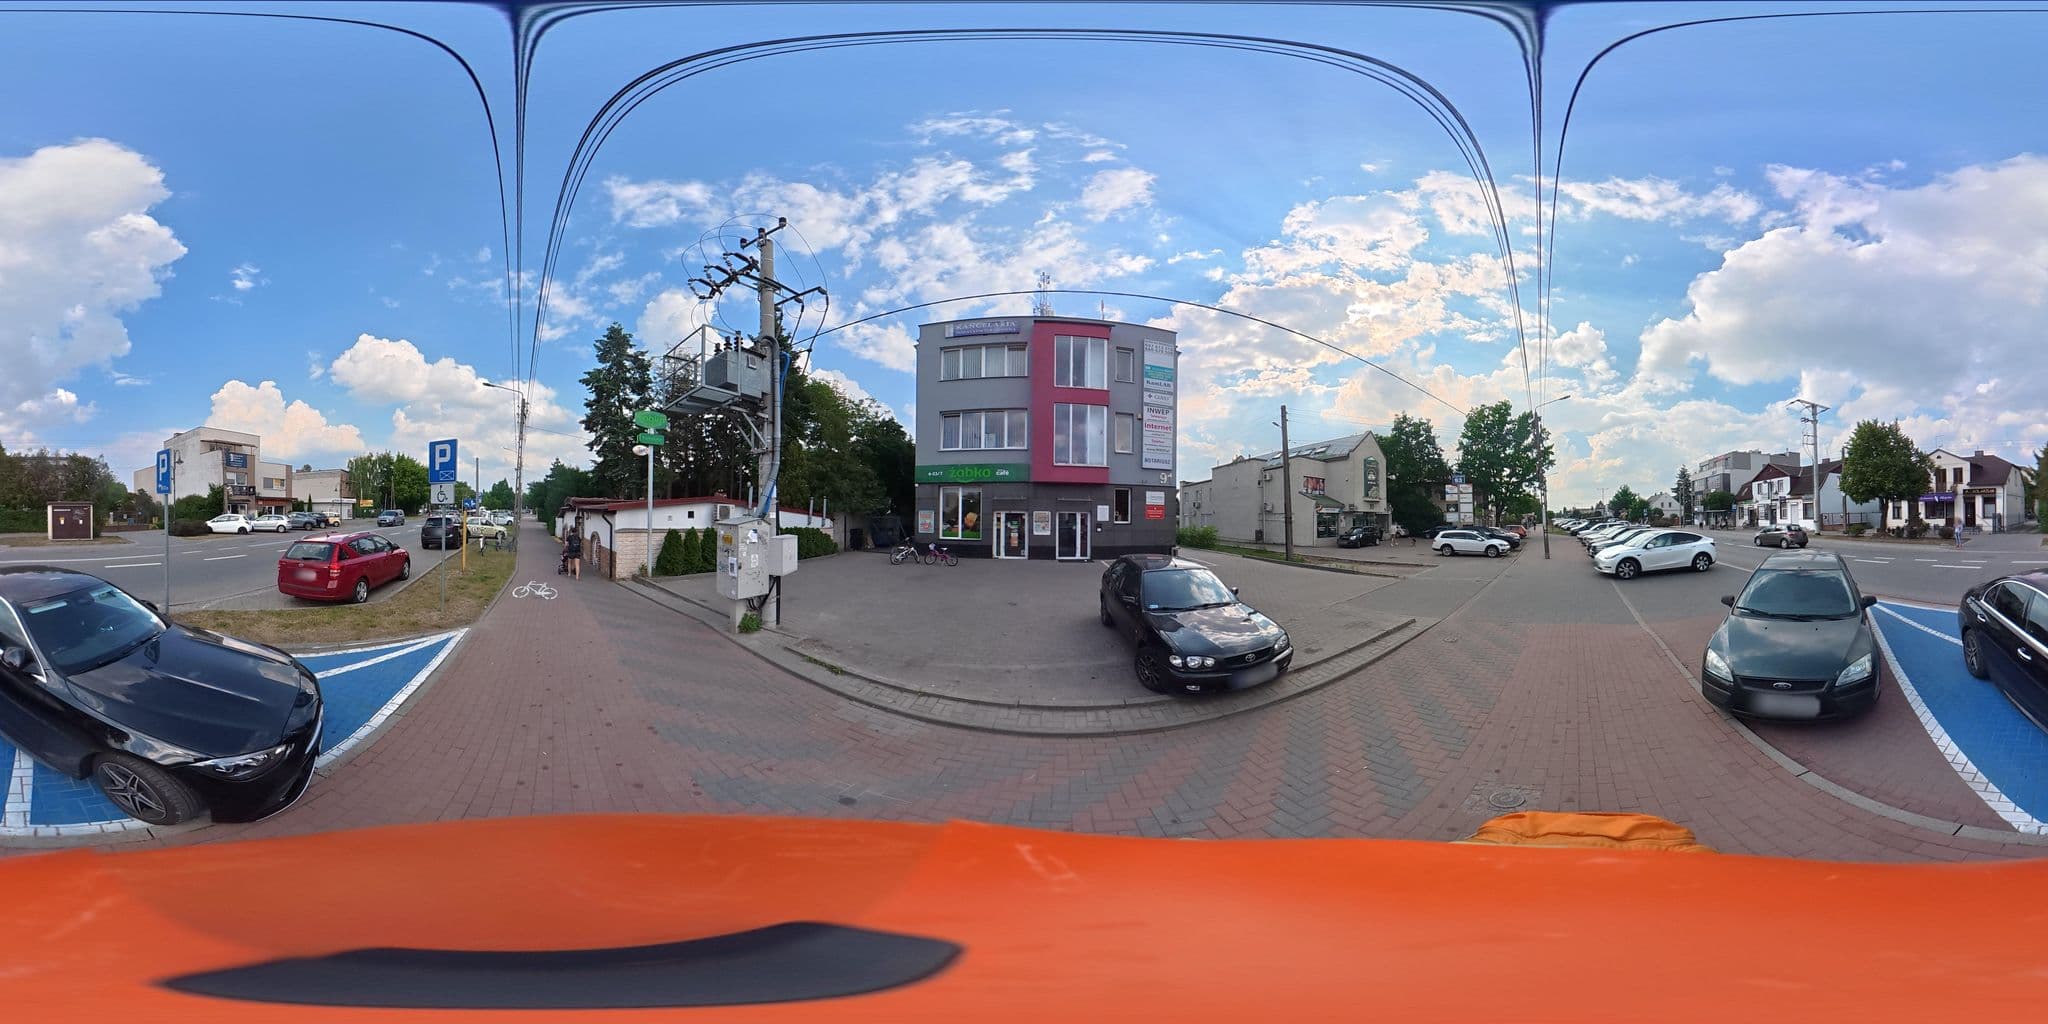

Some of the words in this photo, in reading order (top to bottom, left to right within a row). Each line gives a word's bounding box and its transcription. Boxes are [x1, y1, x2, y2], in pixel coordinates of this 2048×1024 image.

[1146, 407, 1170, 416] INWEP
[1144, 422, 1172, 432] Internet
[435, 444, 451, 471] P
[159, 453, 168, 481] P
[951, 466, 991, 479] żabka
